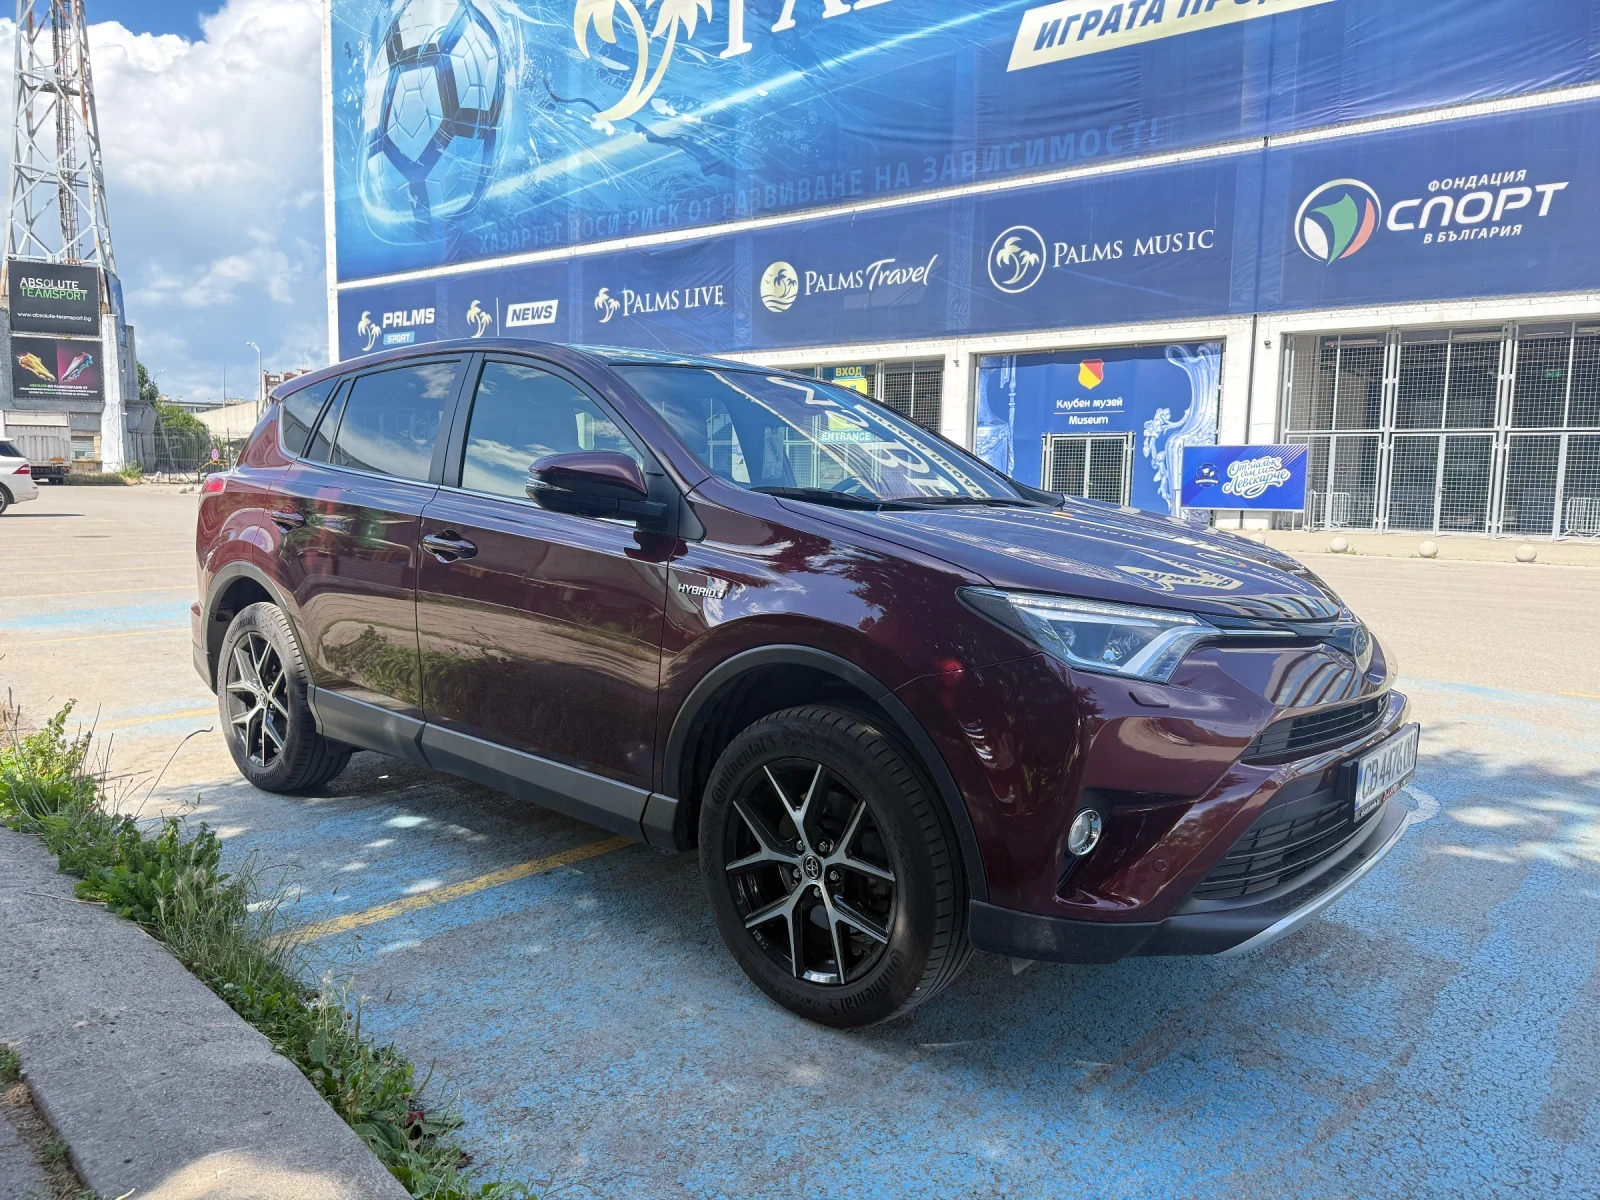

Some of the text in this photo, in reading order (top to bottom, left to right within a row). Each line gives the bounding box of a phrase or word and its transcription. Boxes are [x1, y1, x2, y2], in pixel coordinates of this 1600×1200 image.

[1033, 0, 1162, 51] ИГРАТА
[479, 118, 1158, 253] ХАЗАРТЪТ НОСИ РИСК ОТ РАЗВИВАНЕ НА ЗАВИСИМОСТ!
[1428, 169, 1527, 192] ФОНДАЦИЯ
[1386, 181, 1569, 231] СПОРТ
[1423, 224, 1522, 244] В БЪЛГАРИЯ
[1053, 229, 1214, 268] PALMS MUSIC
[20, 277, 79, 290] ABSOLUTE
[804, 254, 939, 296] PALMS Travel
[21, 287, 87, 300] TEAMSPORT
[621, 285, 724, 317] PALMS LIVE
[17, 311, 92, 322] www.absolute-teamsport.bg
[382, 307, 435, 328] PALMS
[511, 305, 554, 322] NEWS
[387, 333, 411, 343] SPORT
[835, 366, 862, 377] ВХОД
[1056, 397, 1123, 410] Клубен музей
[1068, 416, 1108, 425] Museum
[822, 431, 872, 441] ENTRANCE
[677, 583, 716, 598] HYBRID
[711, 737, 767, 804] Continental
